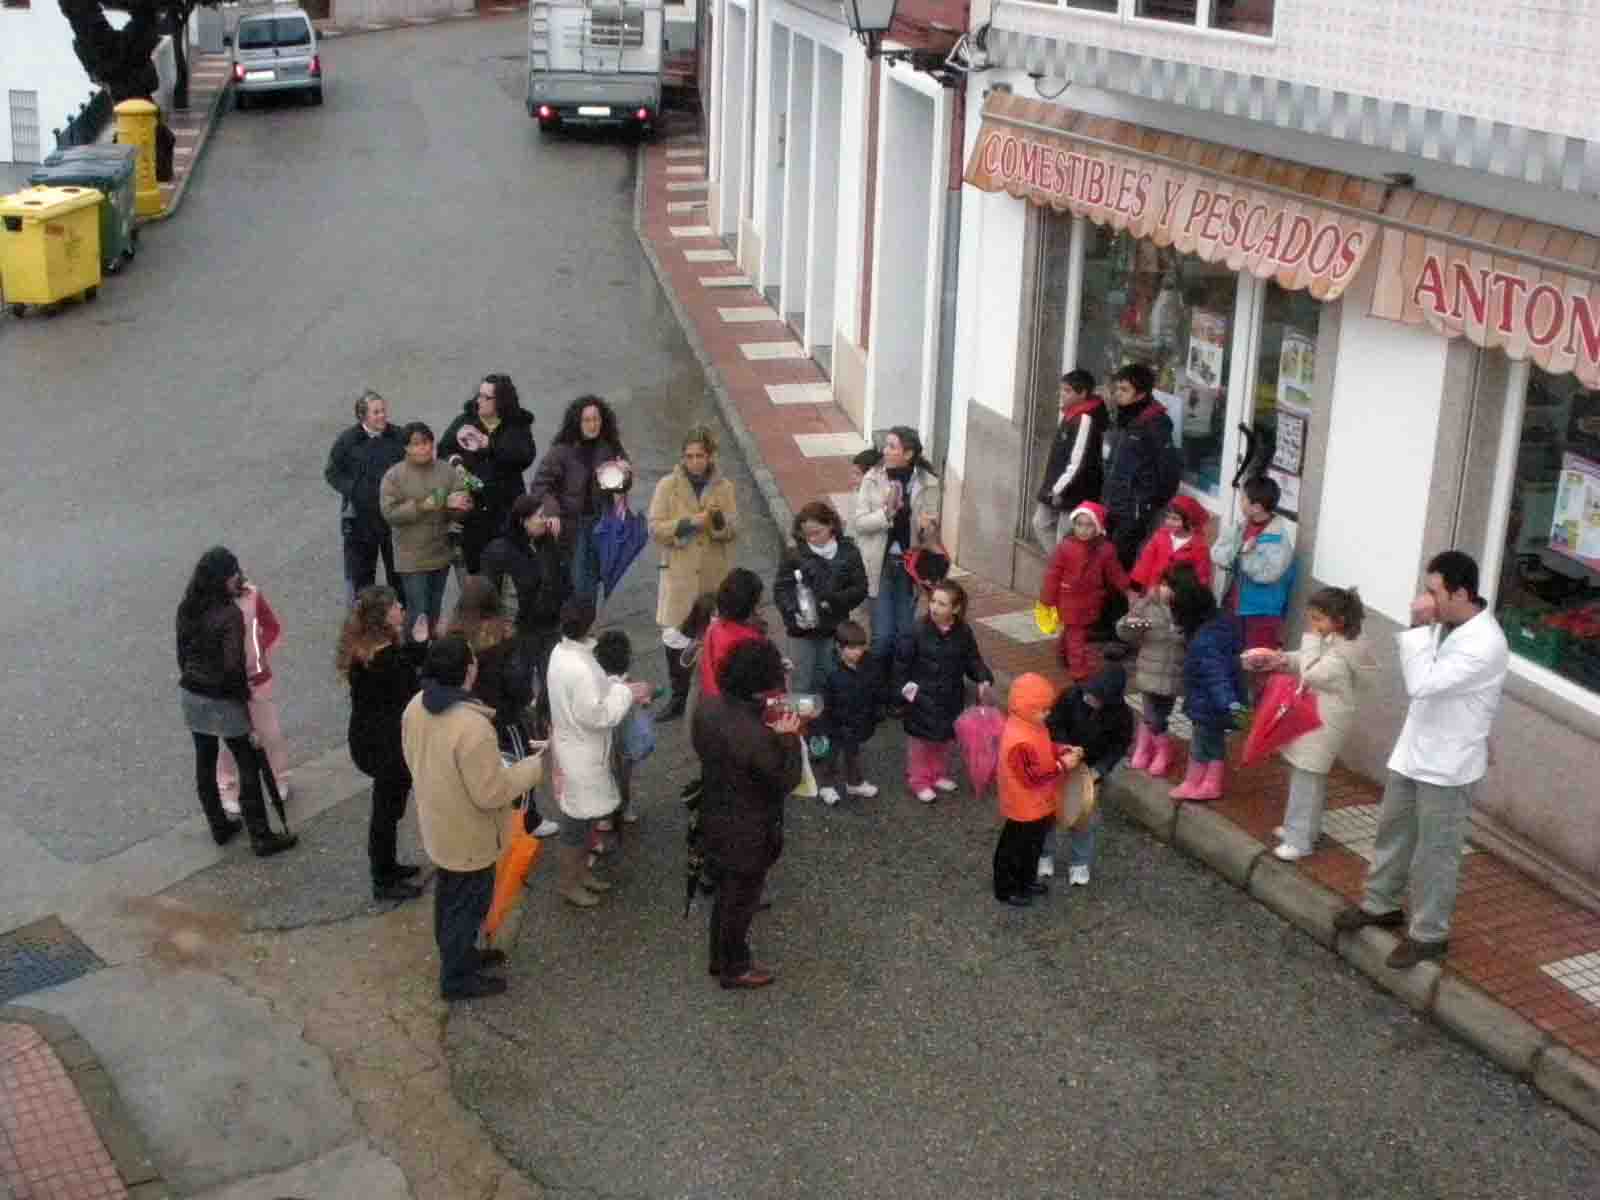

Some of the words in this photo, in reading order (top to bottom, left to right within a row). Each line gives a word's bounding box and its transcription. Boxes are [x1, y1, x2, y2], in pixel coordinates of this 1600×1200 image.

[984, 133, 1152, 217] COMESTIBLES
[1159, 178, 1183, 226] Y
[1184, 188, 1363, 280] PESCADOS
[1413, 256, 1600, 363] ANTON
